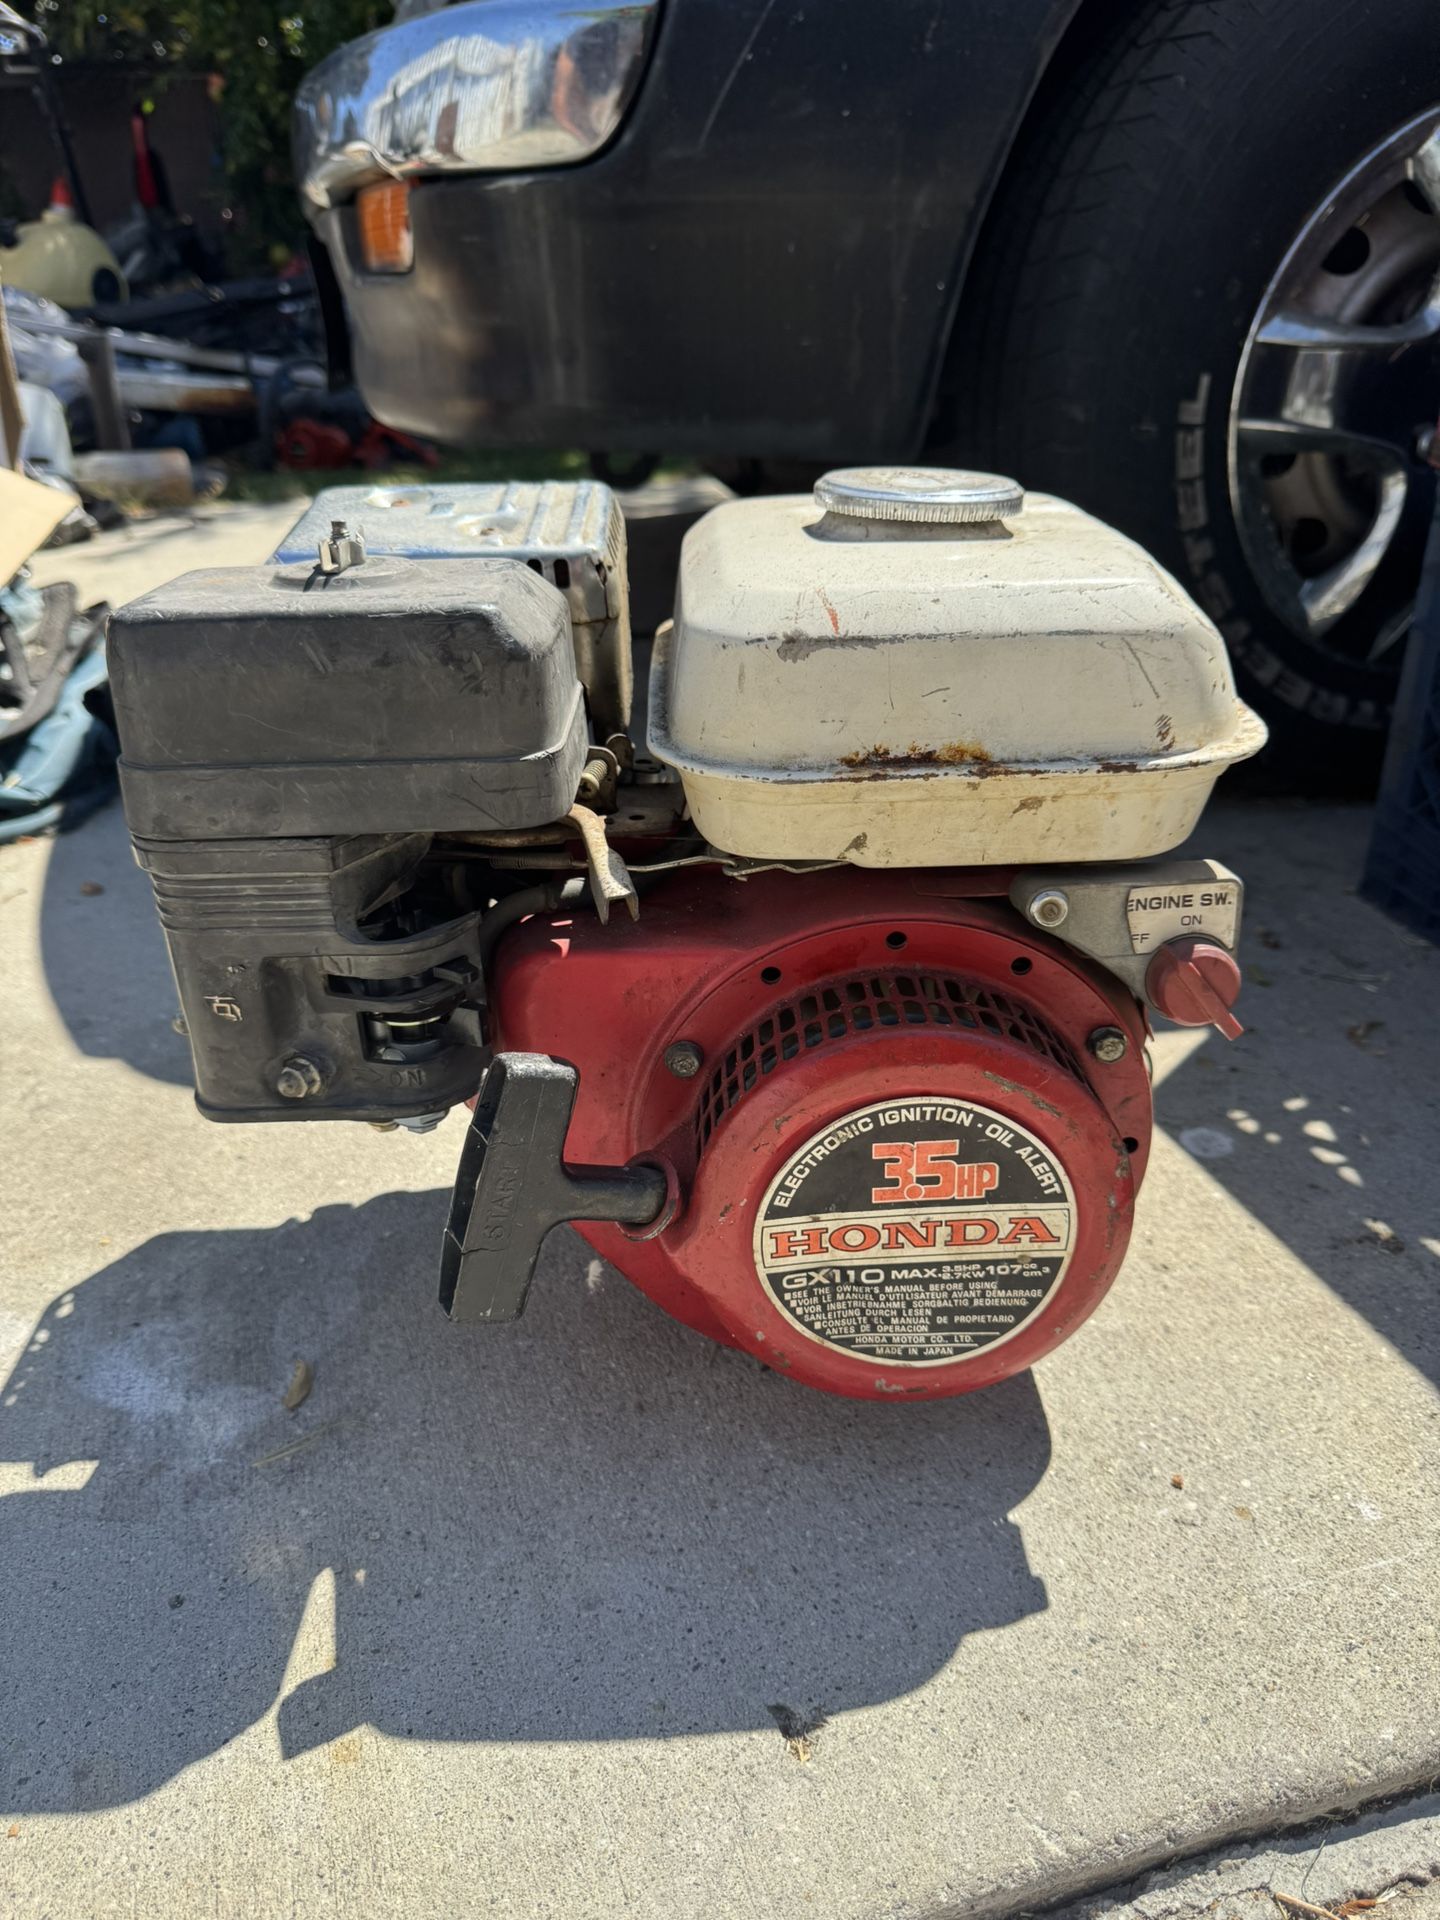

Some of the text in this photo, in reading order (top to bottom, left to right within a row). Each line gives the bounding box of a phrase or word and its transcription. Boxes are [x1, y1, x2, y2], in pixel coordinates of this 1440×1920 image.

[1173, 372, 1391, 731] TREET STEEL
[1127, 891, 1233, 912] ENGINE SW.
[1180, 914, 1202, 926] ON
[773, 1106, 1062, 1208] ELECTRONIC IGNITION OIL ALERT
[769, 1217, 1061, 1259] HONDA
[782, 1267, 886, 1289] GX110
[890, 1268, 942, 1279] MAX.
[985, 1264, 1024, 1275] 107
[792, 1289, 809, 1299] SEE
[812, 1286, 831, 1296] THE
[836, 1284, 880, 1295] OWNER'S
[884, 1283, 925, 1293] MANUAL
[928, 1282, 964, 1291] BEFORE
[797, 1297, 819, 1307] VOIR
[821, 1294, 833, 1303] LE
[836, 1293, 874, 1302] MANUEL
[879, 1290, 949, 1301] D'UTILISATEUR
[951, 1289, 982, 1298] AVANT
[803, 1305, 822, 1314] VOR
[826, 1300, 907, 1311] INBETRIEBNAHME
[804, 1307, 932, 1323] SANLEITUNG DURCH LESEN
[821, 1314, 1016, 1328] CONSULTE EL MANUAL DE PROPIETARIO
[825, 1327, 856, 1336] ANTES
[860, 1325, 871, 1333] DE
[855, 1335, 888, 1344] HONDA
[891, 1335, 926, 1344] MOTOR
[953, 1334, 975, 1343] LTD.
[875, 1346, 954, 1356] MADE IN JAPAN
